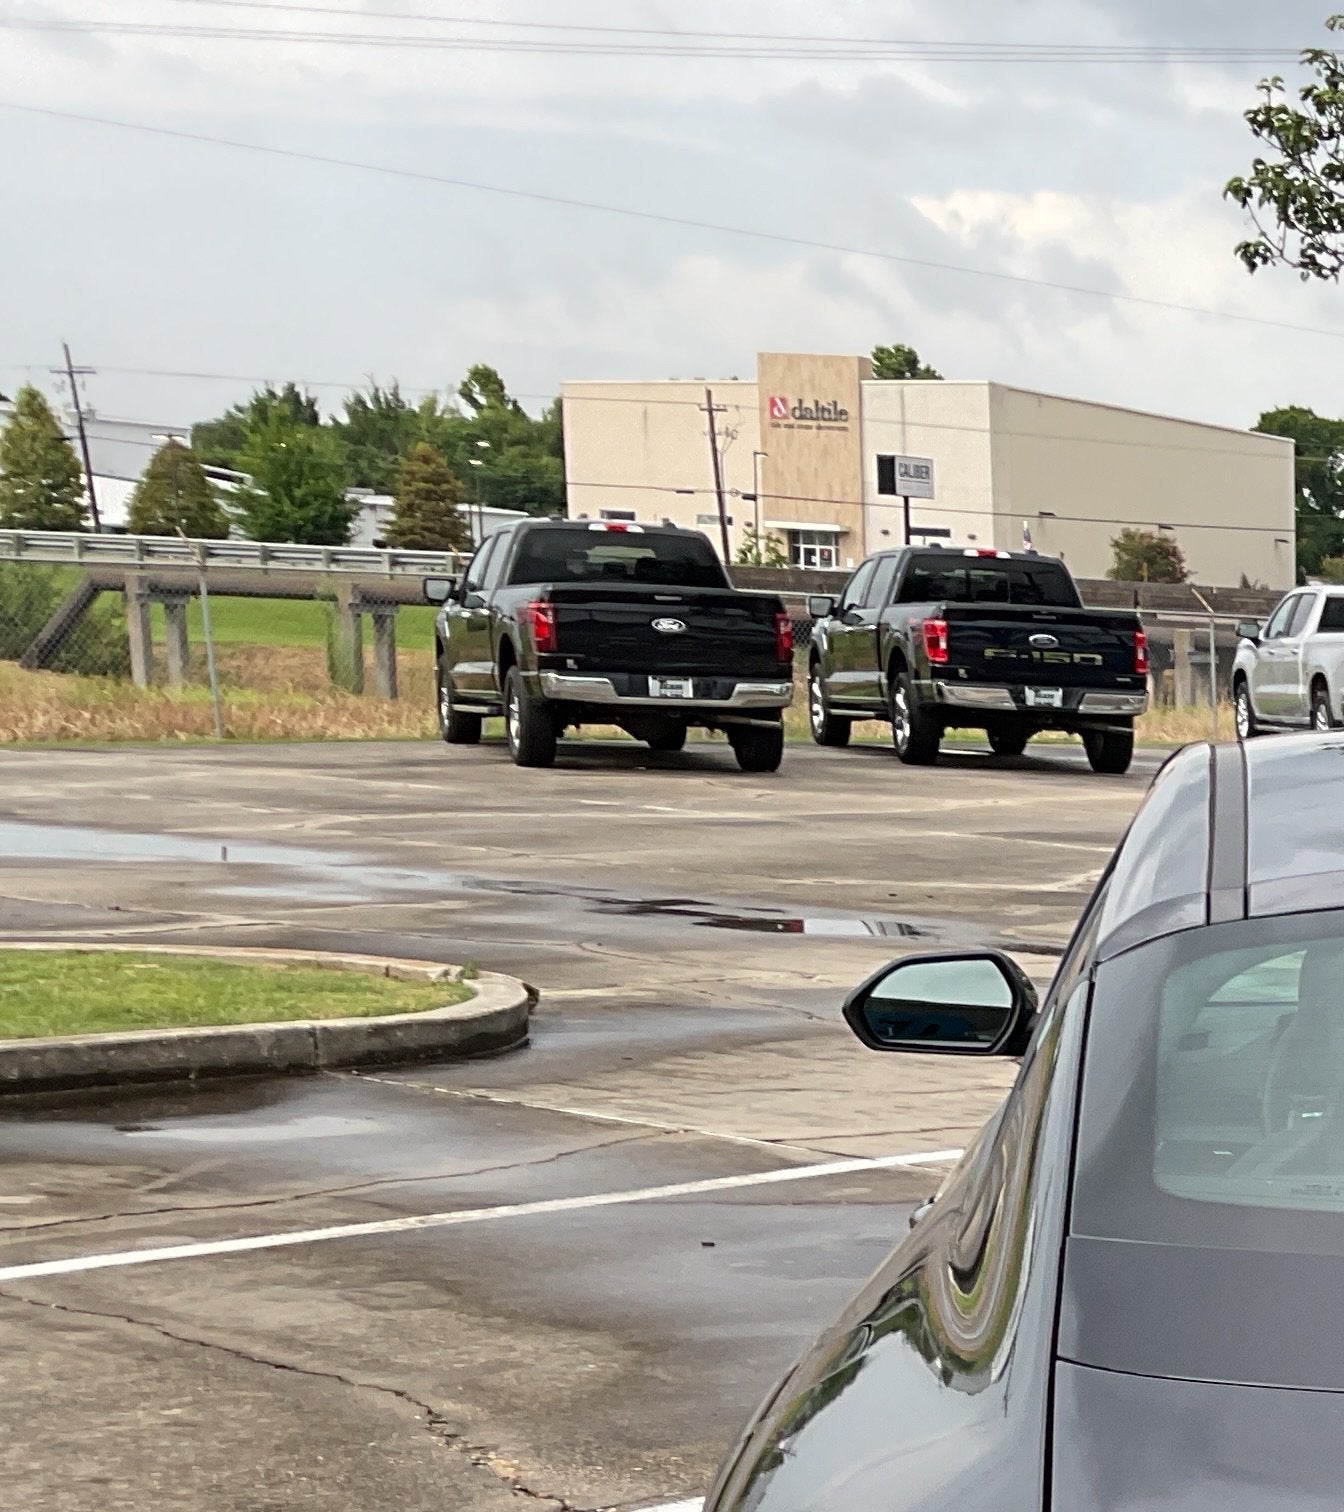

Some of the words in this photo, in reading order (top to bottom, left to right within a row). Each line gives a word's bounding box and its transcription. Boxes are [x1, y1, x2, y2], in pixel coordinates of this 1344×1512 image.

[791, 398, 849, 423] daltile
[899, 462, 930, 480] CALIBER
[983, 648, 1104, 666] F-150
